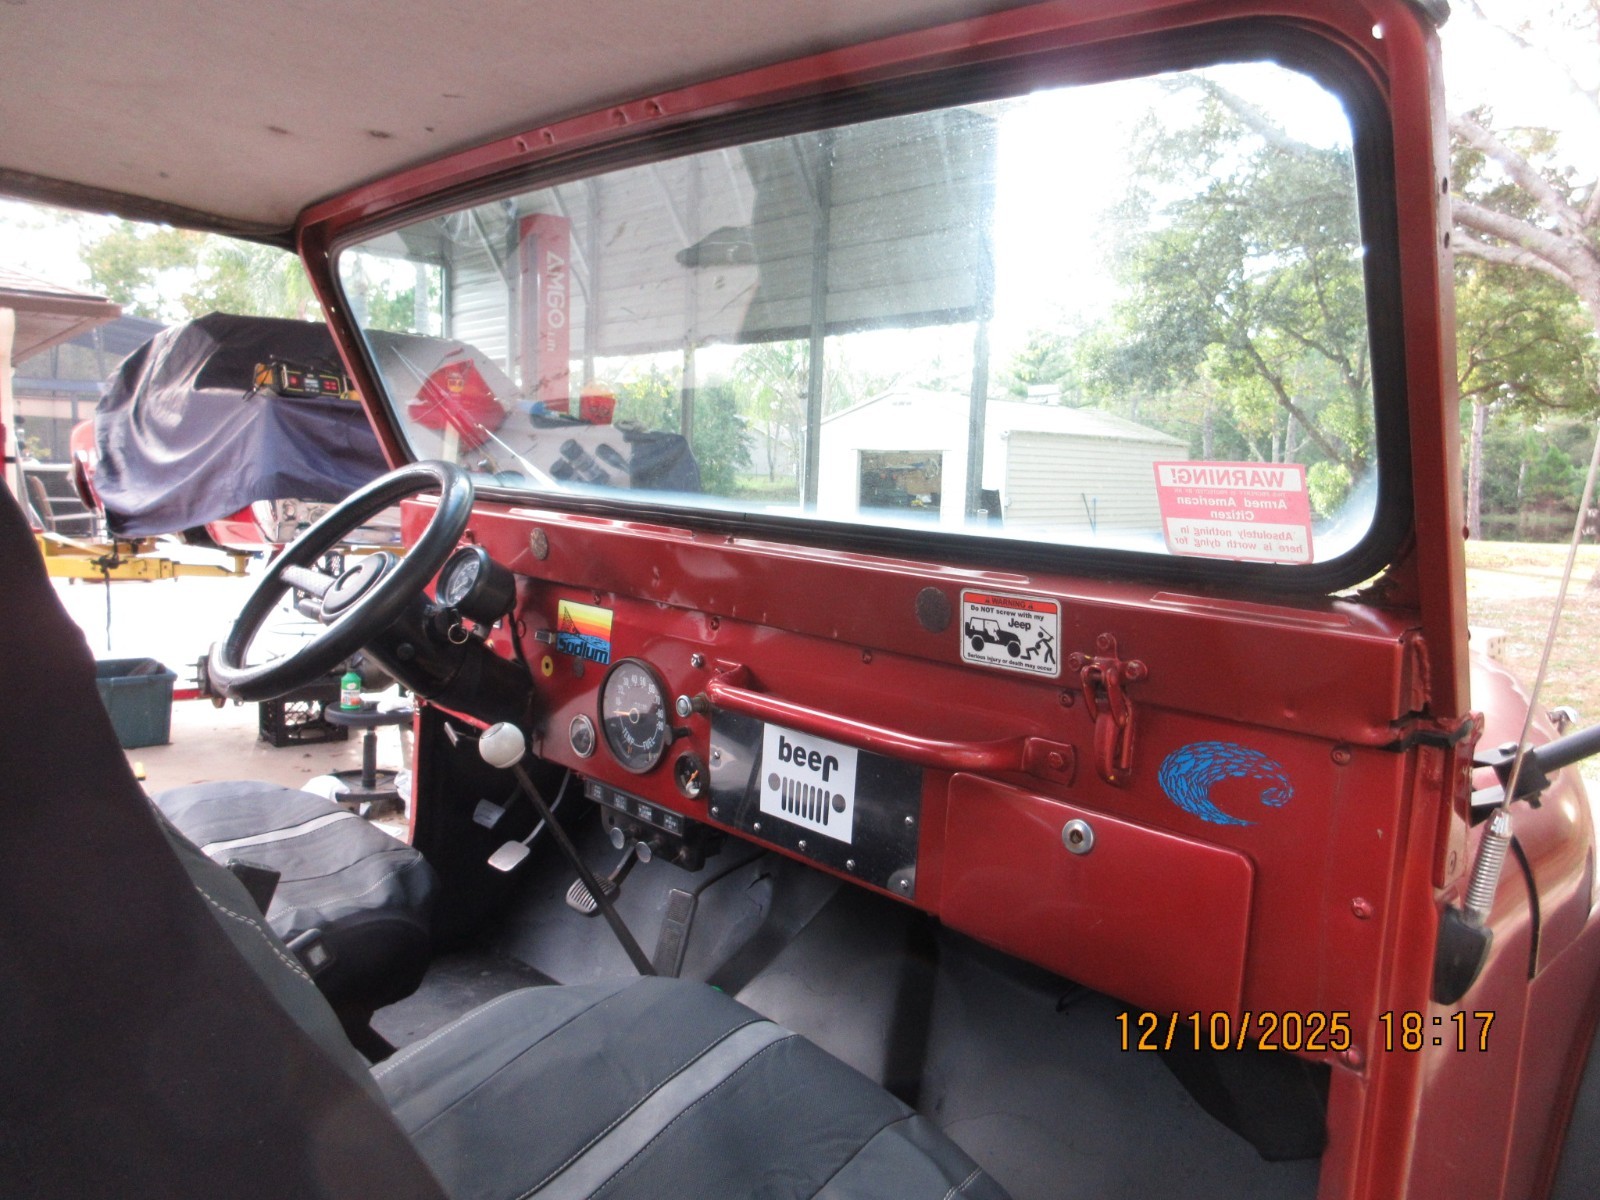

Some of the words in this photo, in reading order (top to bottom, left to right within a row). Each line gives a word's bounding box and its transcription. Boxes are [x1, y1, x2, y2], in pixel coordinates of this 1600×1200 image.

[547, 251, 565, 329] AMGO
[991, 597, 1026, 609] WARNING
[981, 605, 994, 613] NOT
[1018, 611, 1032, 619] with
[1008, 618, 1031, 631] Jeep
[967, 652, 986, 660] Serious
[1008, 659, 1023, 667] death
[1025, 662, 1035, 670] may
[778, 735, 839, 782] beer
